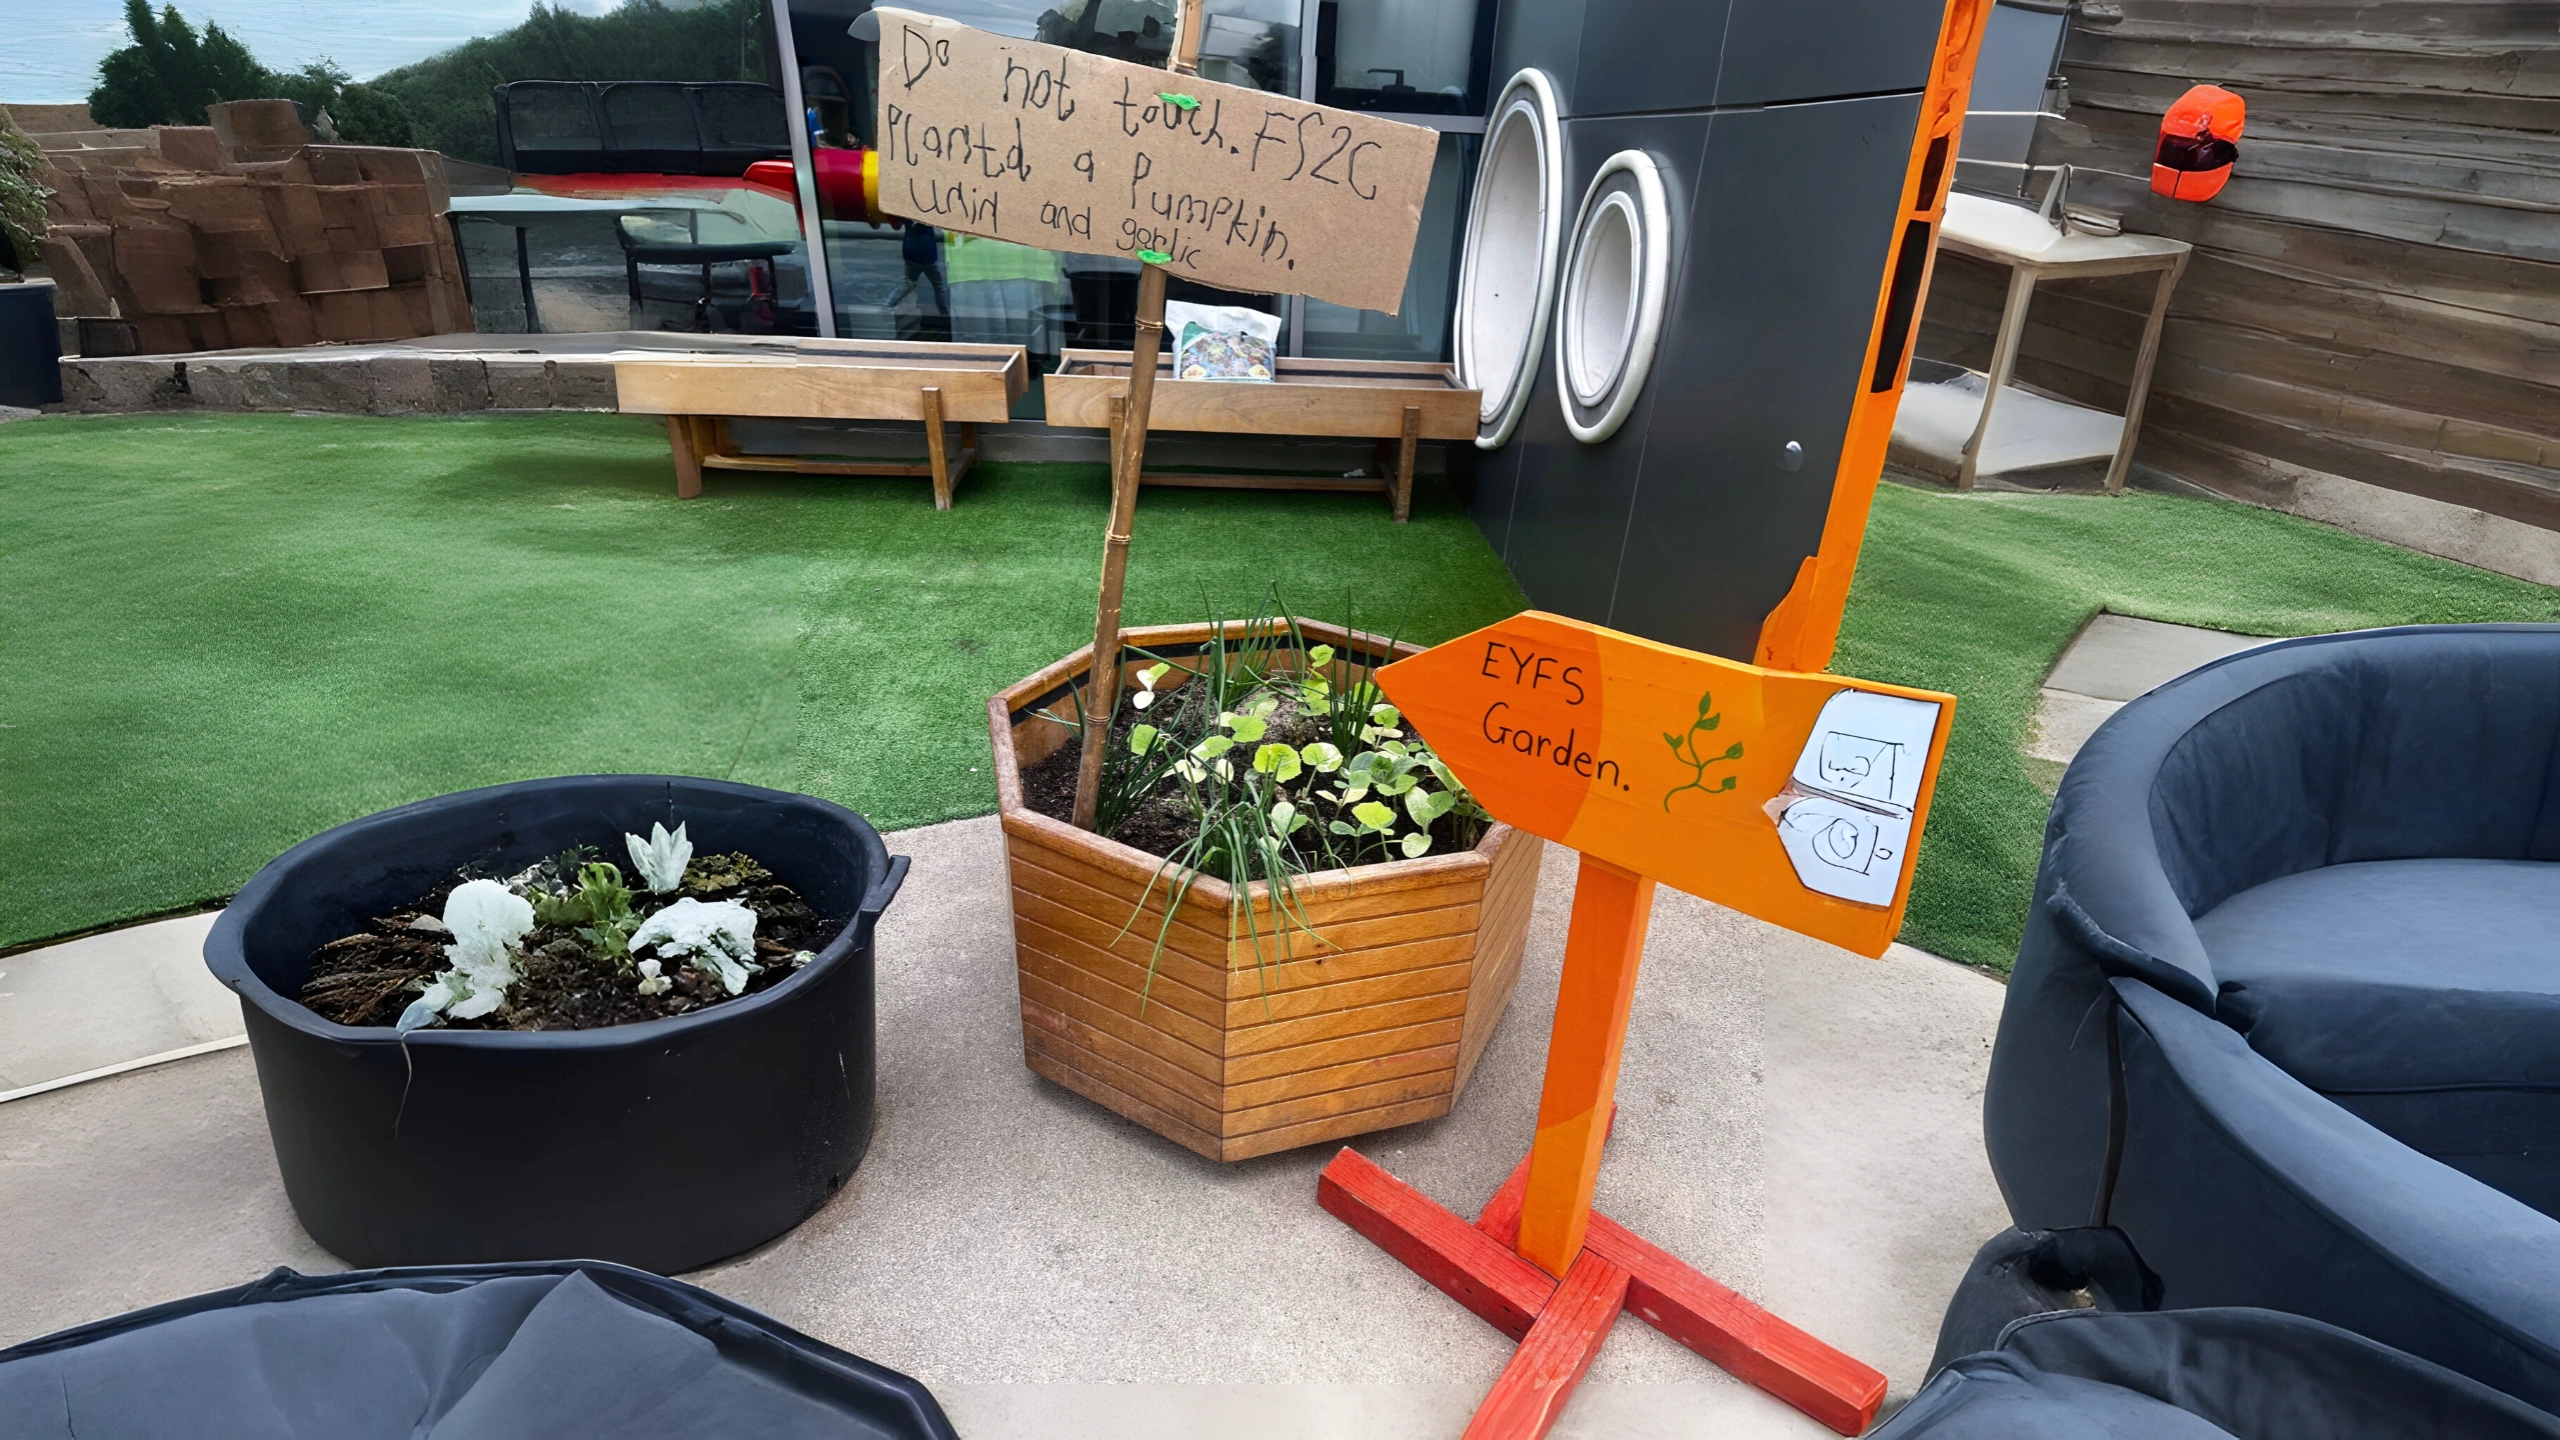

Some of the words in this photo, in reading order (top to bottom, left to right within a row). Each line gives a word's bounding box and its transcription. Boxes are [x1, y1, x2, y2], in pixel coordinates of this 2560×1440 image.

[904, 24, 950, 91] Do
[1003, 56, 1076, 122] not
[1113, 76, 1240, 154] touch.
[1251, 111, 1382, 200] FS2C
[1073, 149, 1095, 183] a
[1040, 200, 1091, 240] and
[1116, 217, 1201, 270] garlic
[1481, 641, 1584, 706] EYFS
[1483, 701, 1630, 792] Garden.
